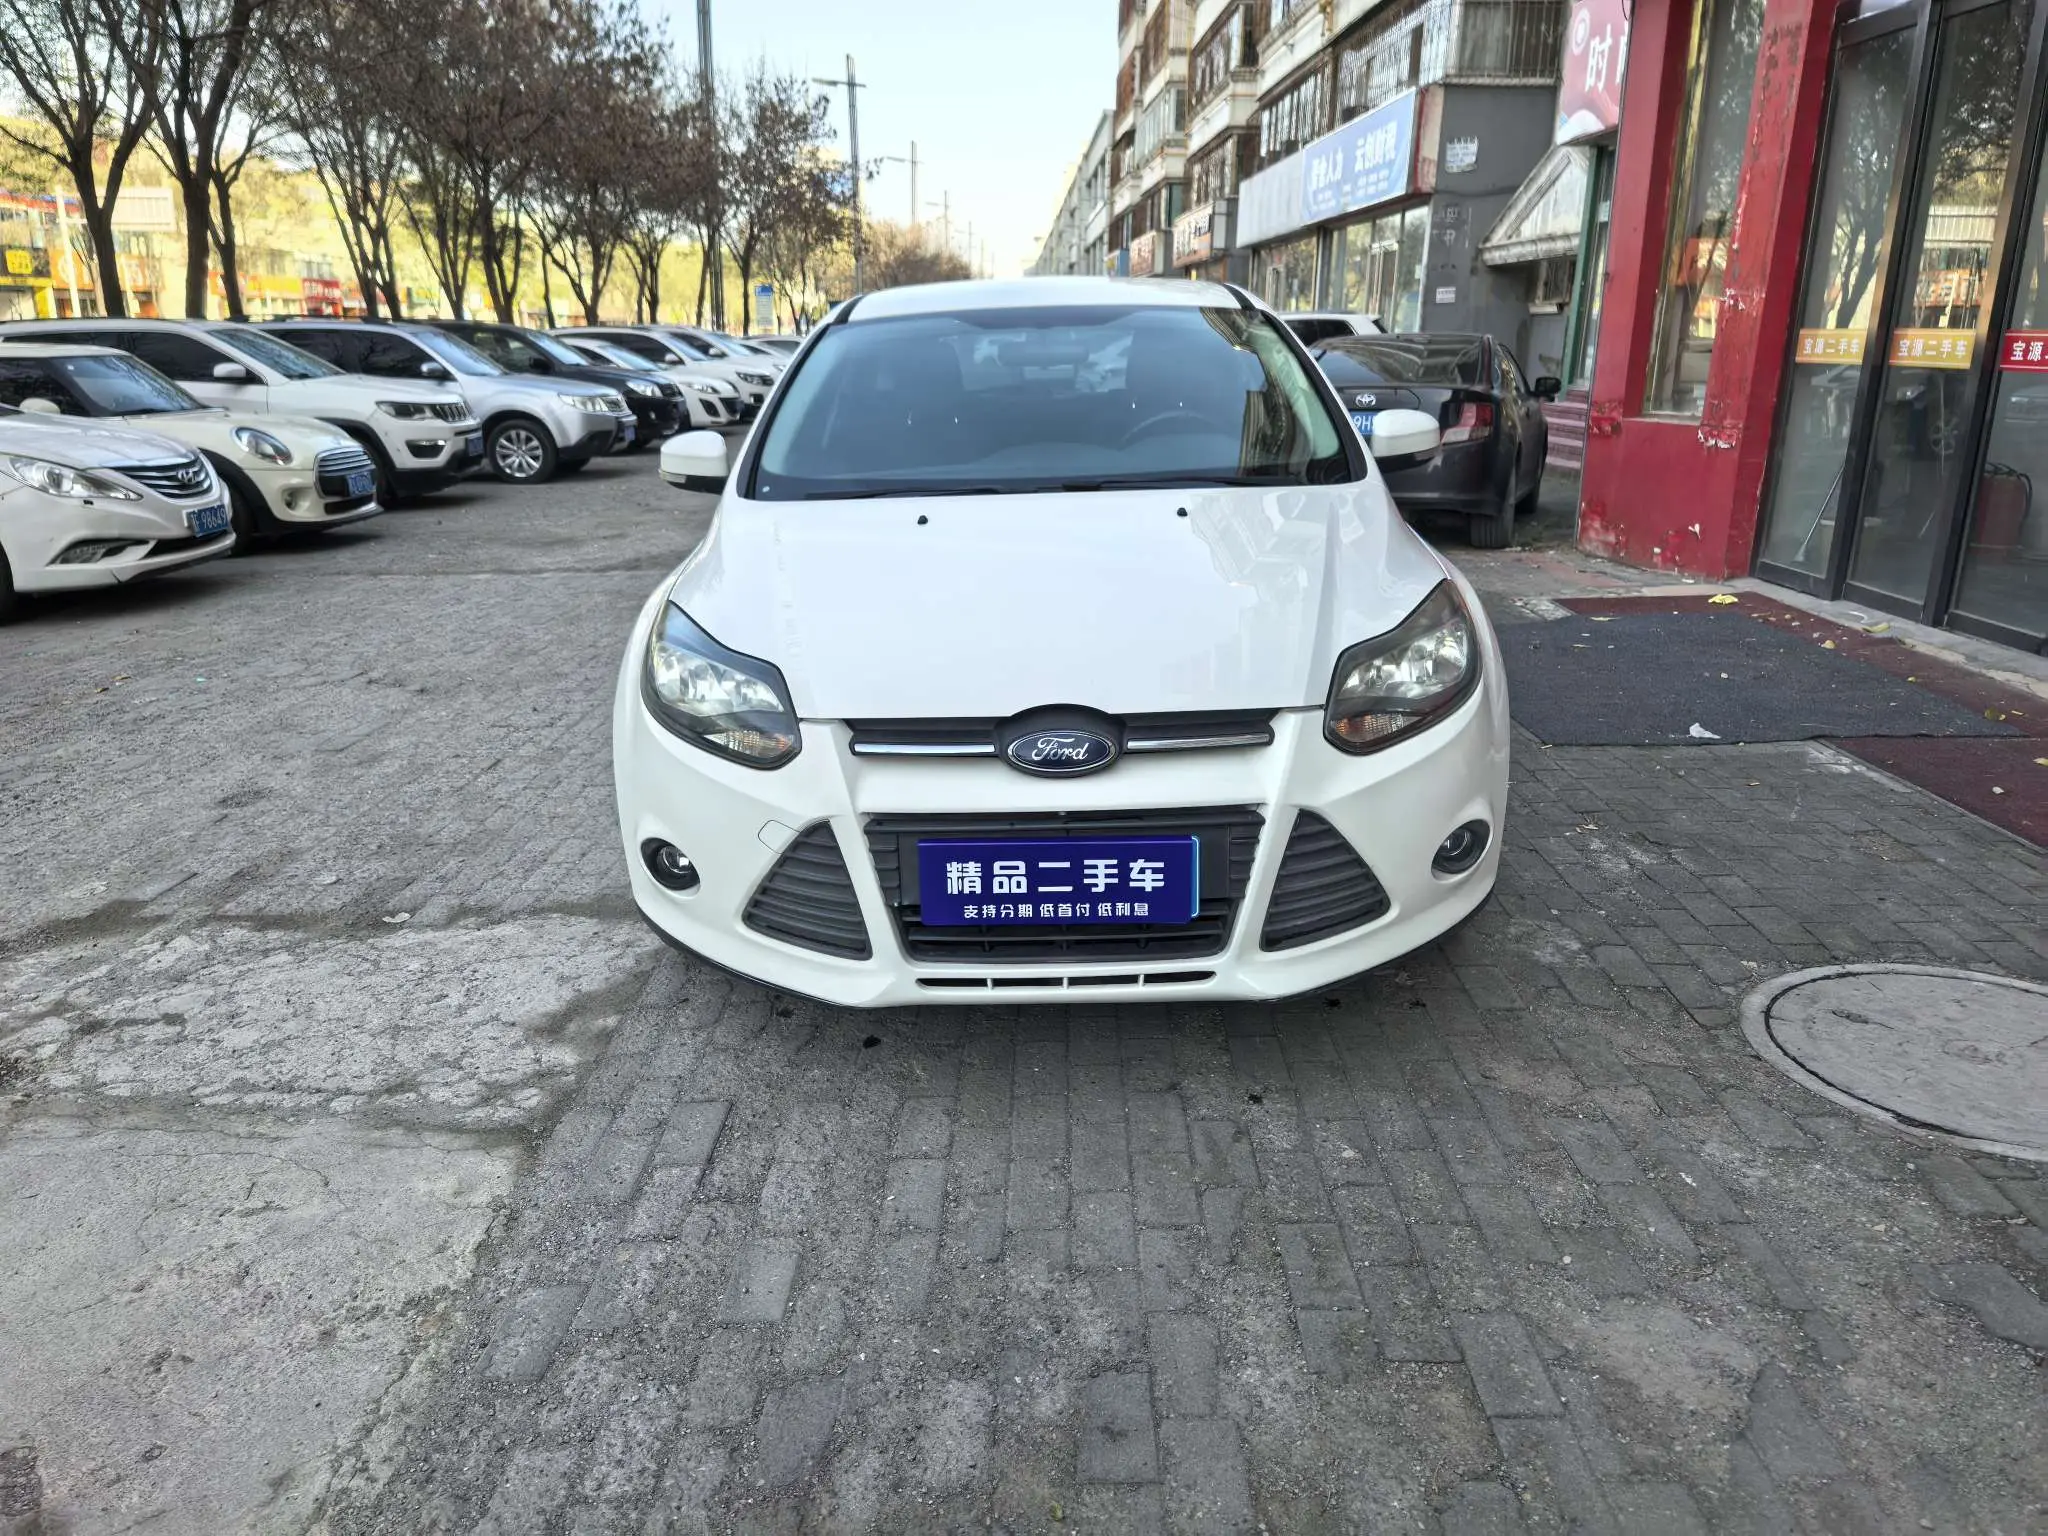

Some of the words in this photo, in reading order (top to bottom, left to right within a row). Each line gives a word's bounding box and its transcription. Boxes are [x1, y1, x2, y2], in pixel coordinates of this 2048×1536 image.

[1584, 20, 1629, 93] 时
[1803, 338, 1860, 355] 宝源二手车
[1898, 338, 1968, 359] 宝源二手车
[2010, 340, 2048, 362] 宝源
[1031, 737, 1089, 761] Ford
[946, 859, 1165, 895] 精品二手车
[963, 904, 1033, 919] 支持分期
[1039, 903, 1090, 918] 低首付
[1097, 902, 1149, 917] 低利息
